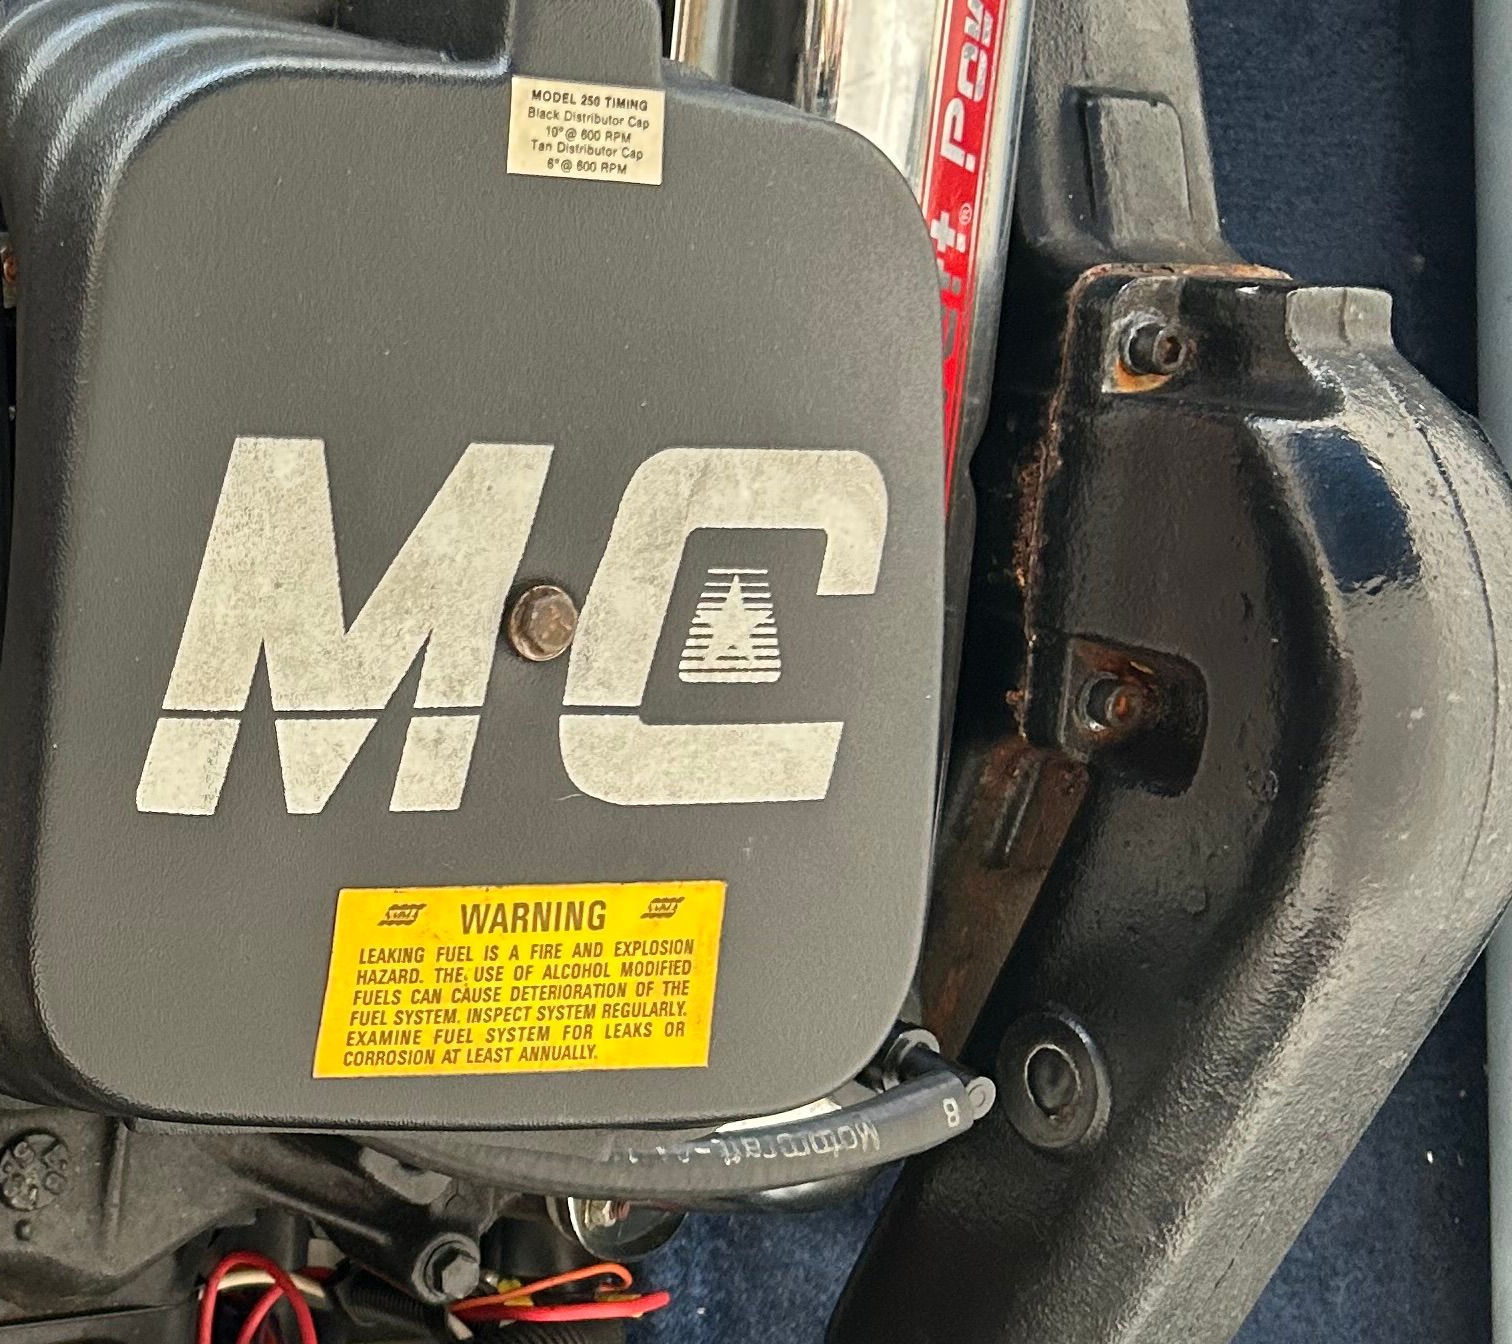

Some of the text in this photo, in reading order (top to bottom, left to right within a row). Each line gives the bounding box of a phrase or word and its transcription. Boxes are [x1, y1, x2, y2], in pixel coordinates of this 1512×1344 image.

[532, 90, 576, 105] MODEL
[605, 97, 648, 111] TIMING
[528, 107, 649, 130] Black Distributor Cap
[565, 128, 577, 142] @
[605, 131, 632, 143] RPM
[531, 139, 643, 160] Tan Distributor Cap
[561, 160, 572, 173] @
[601, 162, 627, 174] RPM
[136, 435, 888, 817] MC
[461, 900, 606, 934] WARNING
[359, 939, 694, 964] LEAKING FUEL IS A FIRE AND EXPLOSION
[356, 960, 691, 985] HAZARD. THE USE OF ALCOHOL MODIFIED
[353, 981, 689, 1005] FUELS CAN CAUSE DETERIORATION OF THE
[350, 1000, 687, 1026] FUEL SYSTEM. INSPECT SYSTEM REGULARLY.
[346, 1021, 685, 1046] EXAMINE FUEL SYSTEM FOR LEAKS OR
[343, 1045, 598, 1067] CORROSION AT LEAST ANNUALLY.
